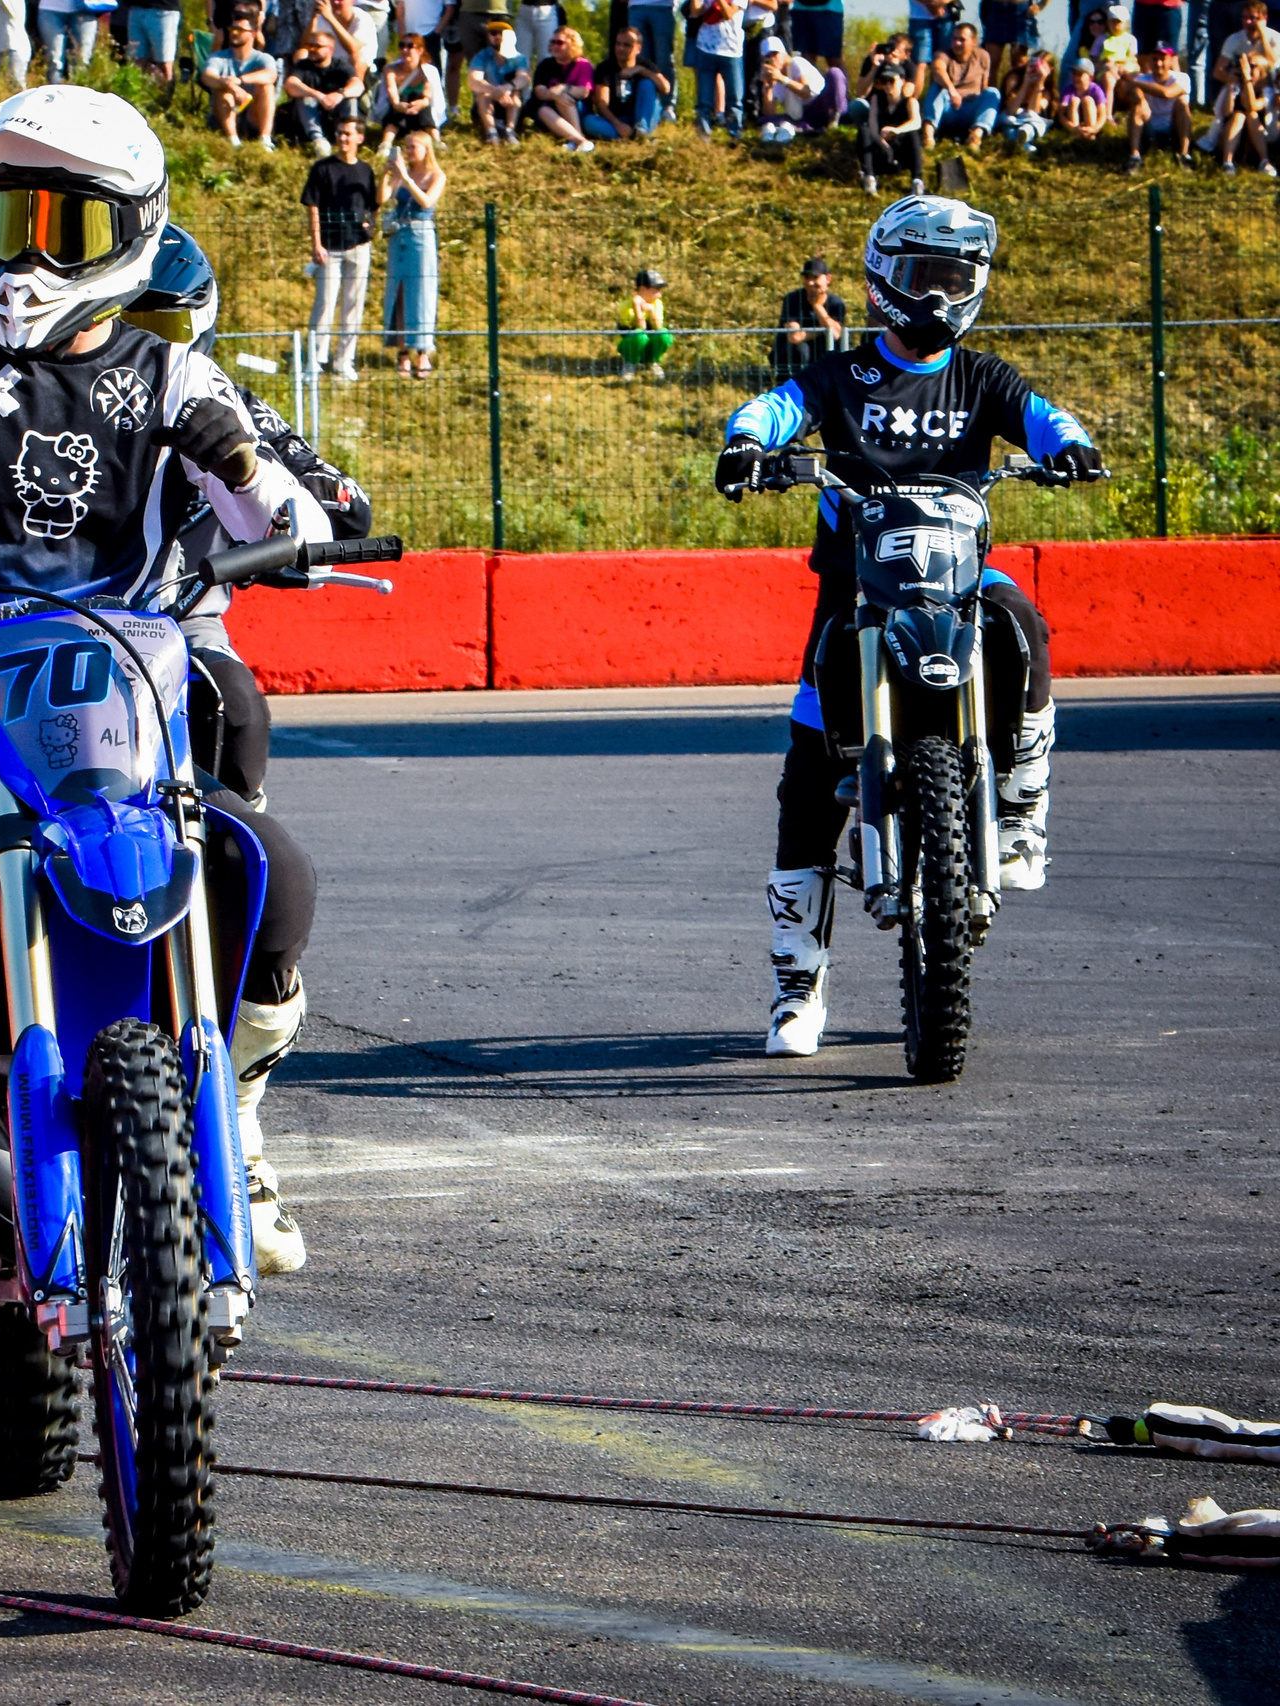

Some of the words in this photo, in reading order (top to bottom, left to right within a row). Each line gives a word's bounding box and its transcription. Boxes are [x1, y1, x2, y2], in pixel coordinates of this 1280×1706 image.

[3, 117, 43, 131] HOEI
[723, 443, 762, 455] ALIPA
[899, 581, 944, 592] Kawasaki
[87, 629, 166, 639] MYSNIKOV
[922, 663, 957, 676] SBS
[18, 1073, 40, 1252] WWW.FMX13.COM
